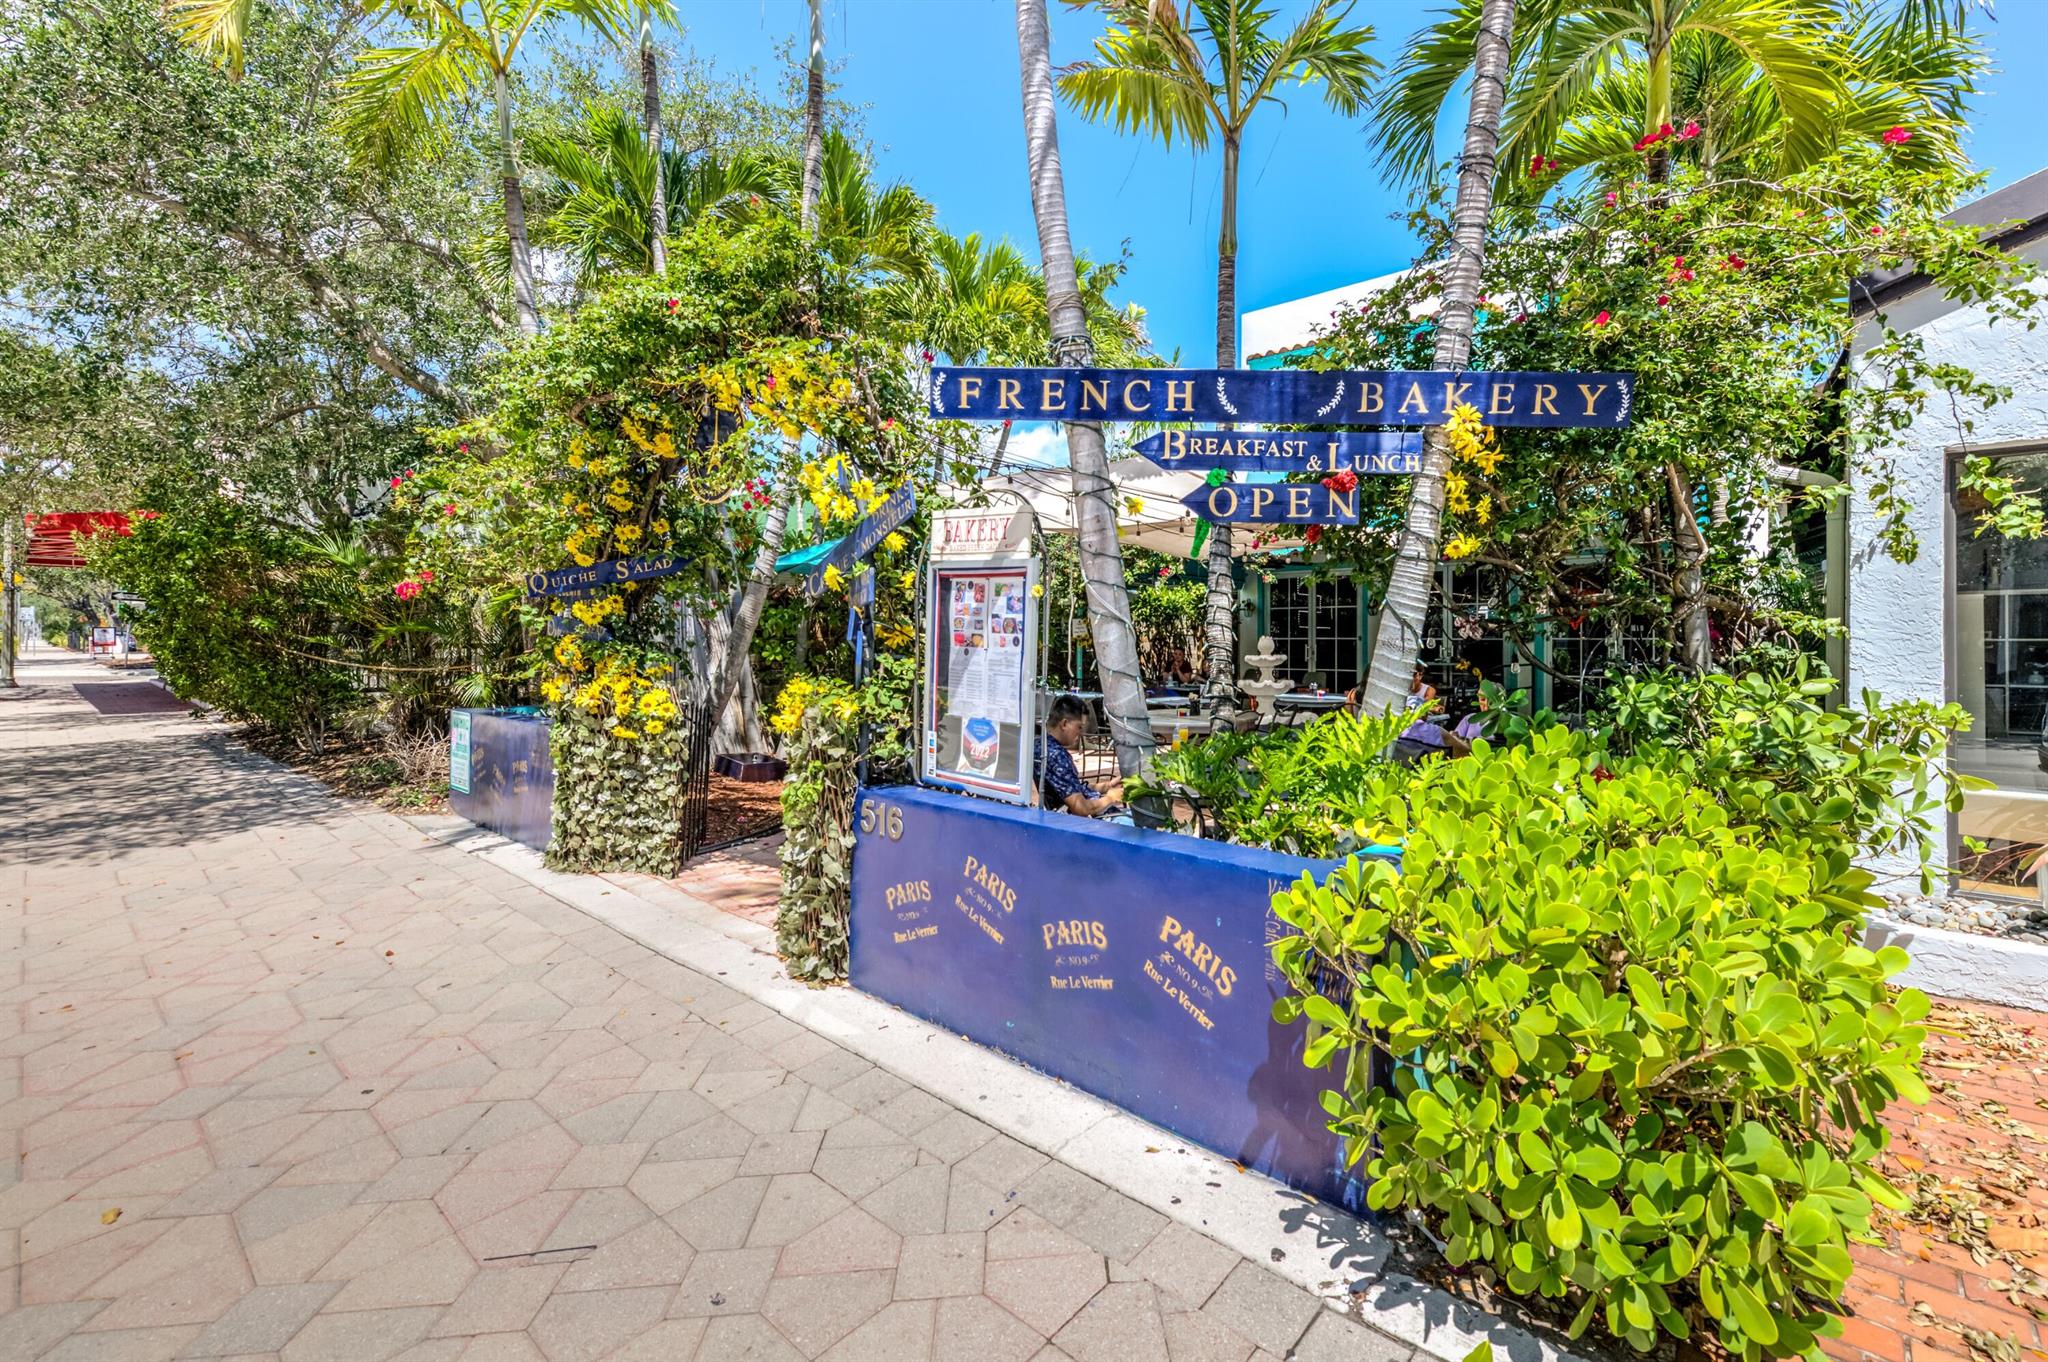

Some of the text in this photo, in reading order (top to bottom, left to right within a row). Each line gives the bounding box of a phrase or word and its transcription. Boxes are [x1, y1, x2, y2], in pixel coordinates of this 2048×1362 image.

[957, 377, 1608, 416] FRENCH BAKERY
[1208, 486, 1356, 518] OPEN
[860, 501, 912, 551] MONSIEUR
[944, 517, 1011, 542] BAKERY
[860, 799, 905, 840] 516
[885, 880, 932, 911] PARIS
[963, 855, 1017, 912] PARIS
[1041, 919, 1108, 950] PARIS
[1159, 915, 1237, 997] PARIS
[1143, 958, 1215, 1031] Rue Le Verrier
